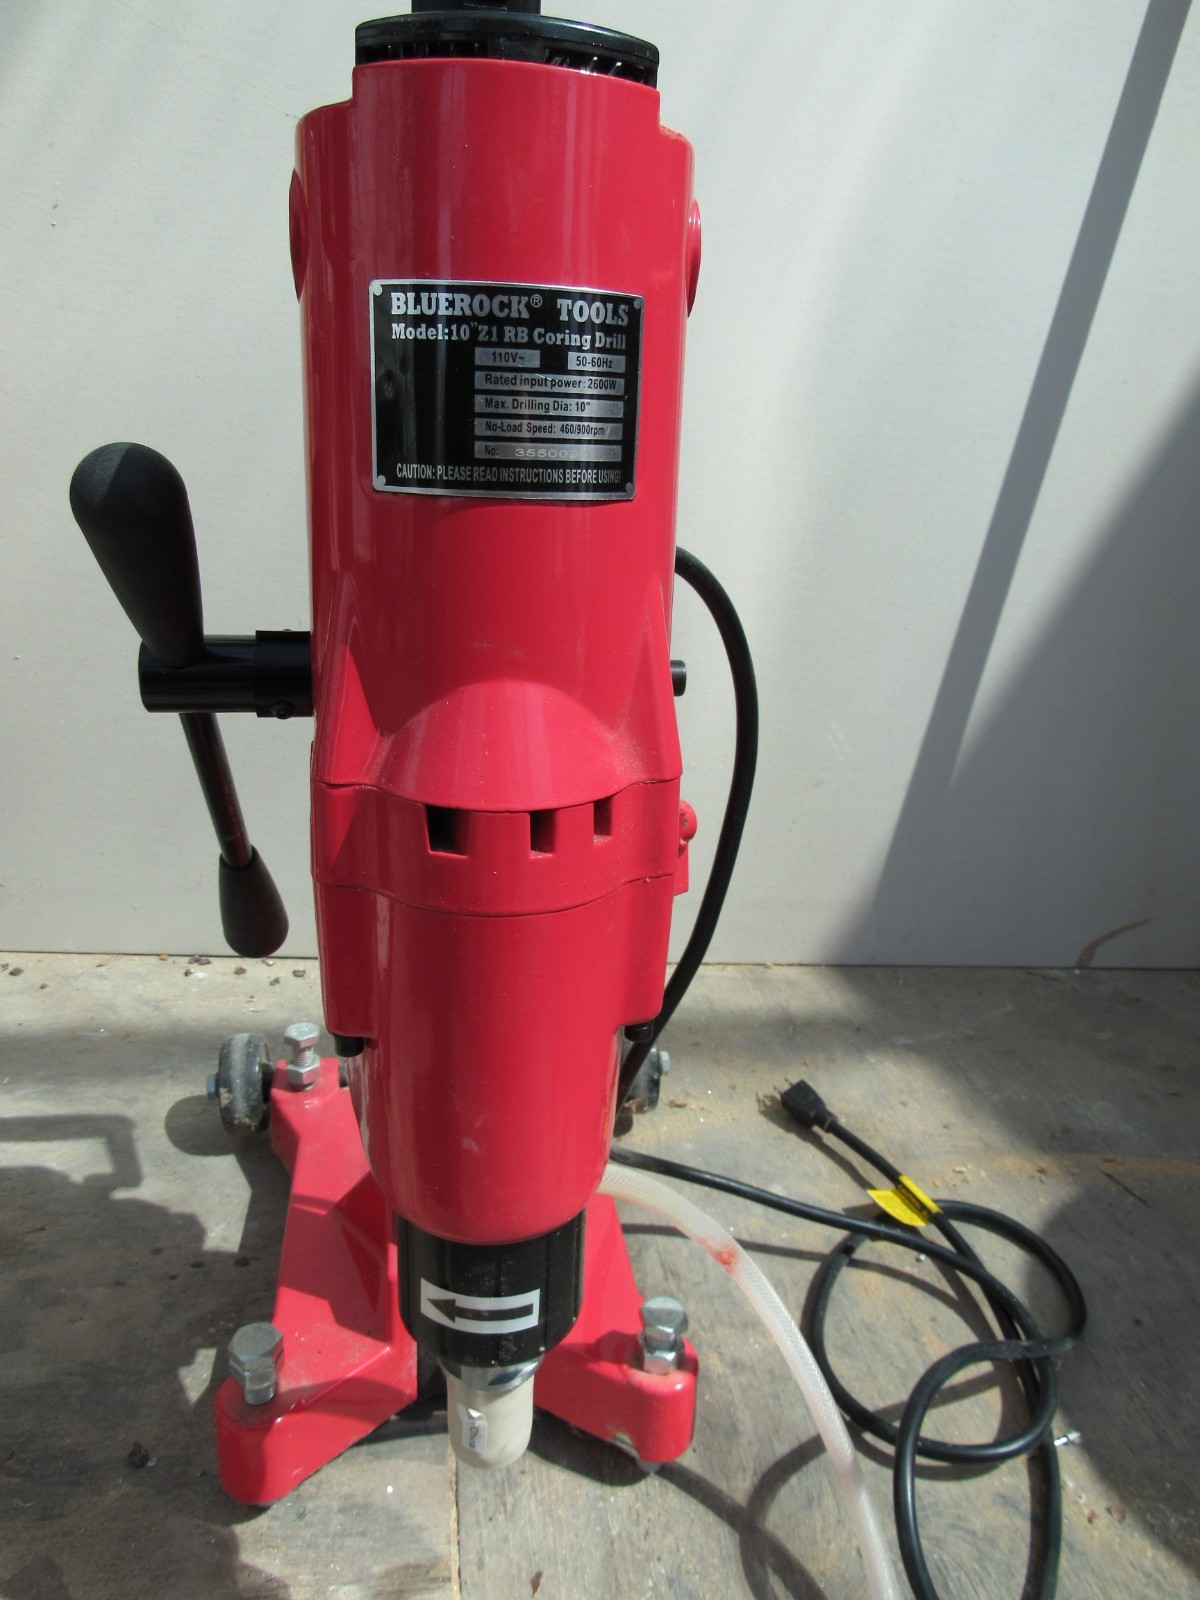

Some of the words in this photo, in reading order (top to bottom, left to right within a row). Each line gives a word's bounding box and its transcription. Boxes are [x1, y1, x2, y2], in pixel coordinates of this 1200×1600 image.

[557, 299, 628, 326] TOOLS
[504, 326, 528, 343] RB
[533, 328, 591, 350] Coring
[595, 332, 626, 349] Drill
[576, 356, 613, 369] 50-60Hz
[485, 374, 517, 387] Rated
[519, 376, 548, 389] input
[588, 379, 617, 391] 2600W
[485, 398, 509, 409] Max.
[512, 399, 550, 413] Drilling
[552, 401, 573, 412] Dia:
[485, 423, 523, 434] No-Load
[526, 424, 556, 436] Speed:
[560, 425, 605, 437] 460/900rpm
[484, 445, 499, 456] No:
[396, 463, 436, 479] CAUTION:
[437, 464, 471, 481] PLEASE
[473, 465, 498, 482] READ
[500, 467, 563, 483] INSTRUCTIONS
[566, 470, 597, 484] BEFORE
